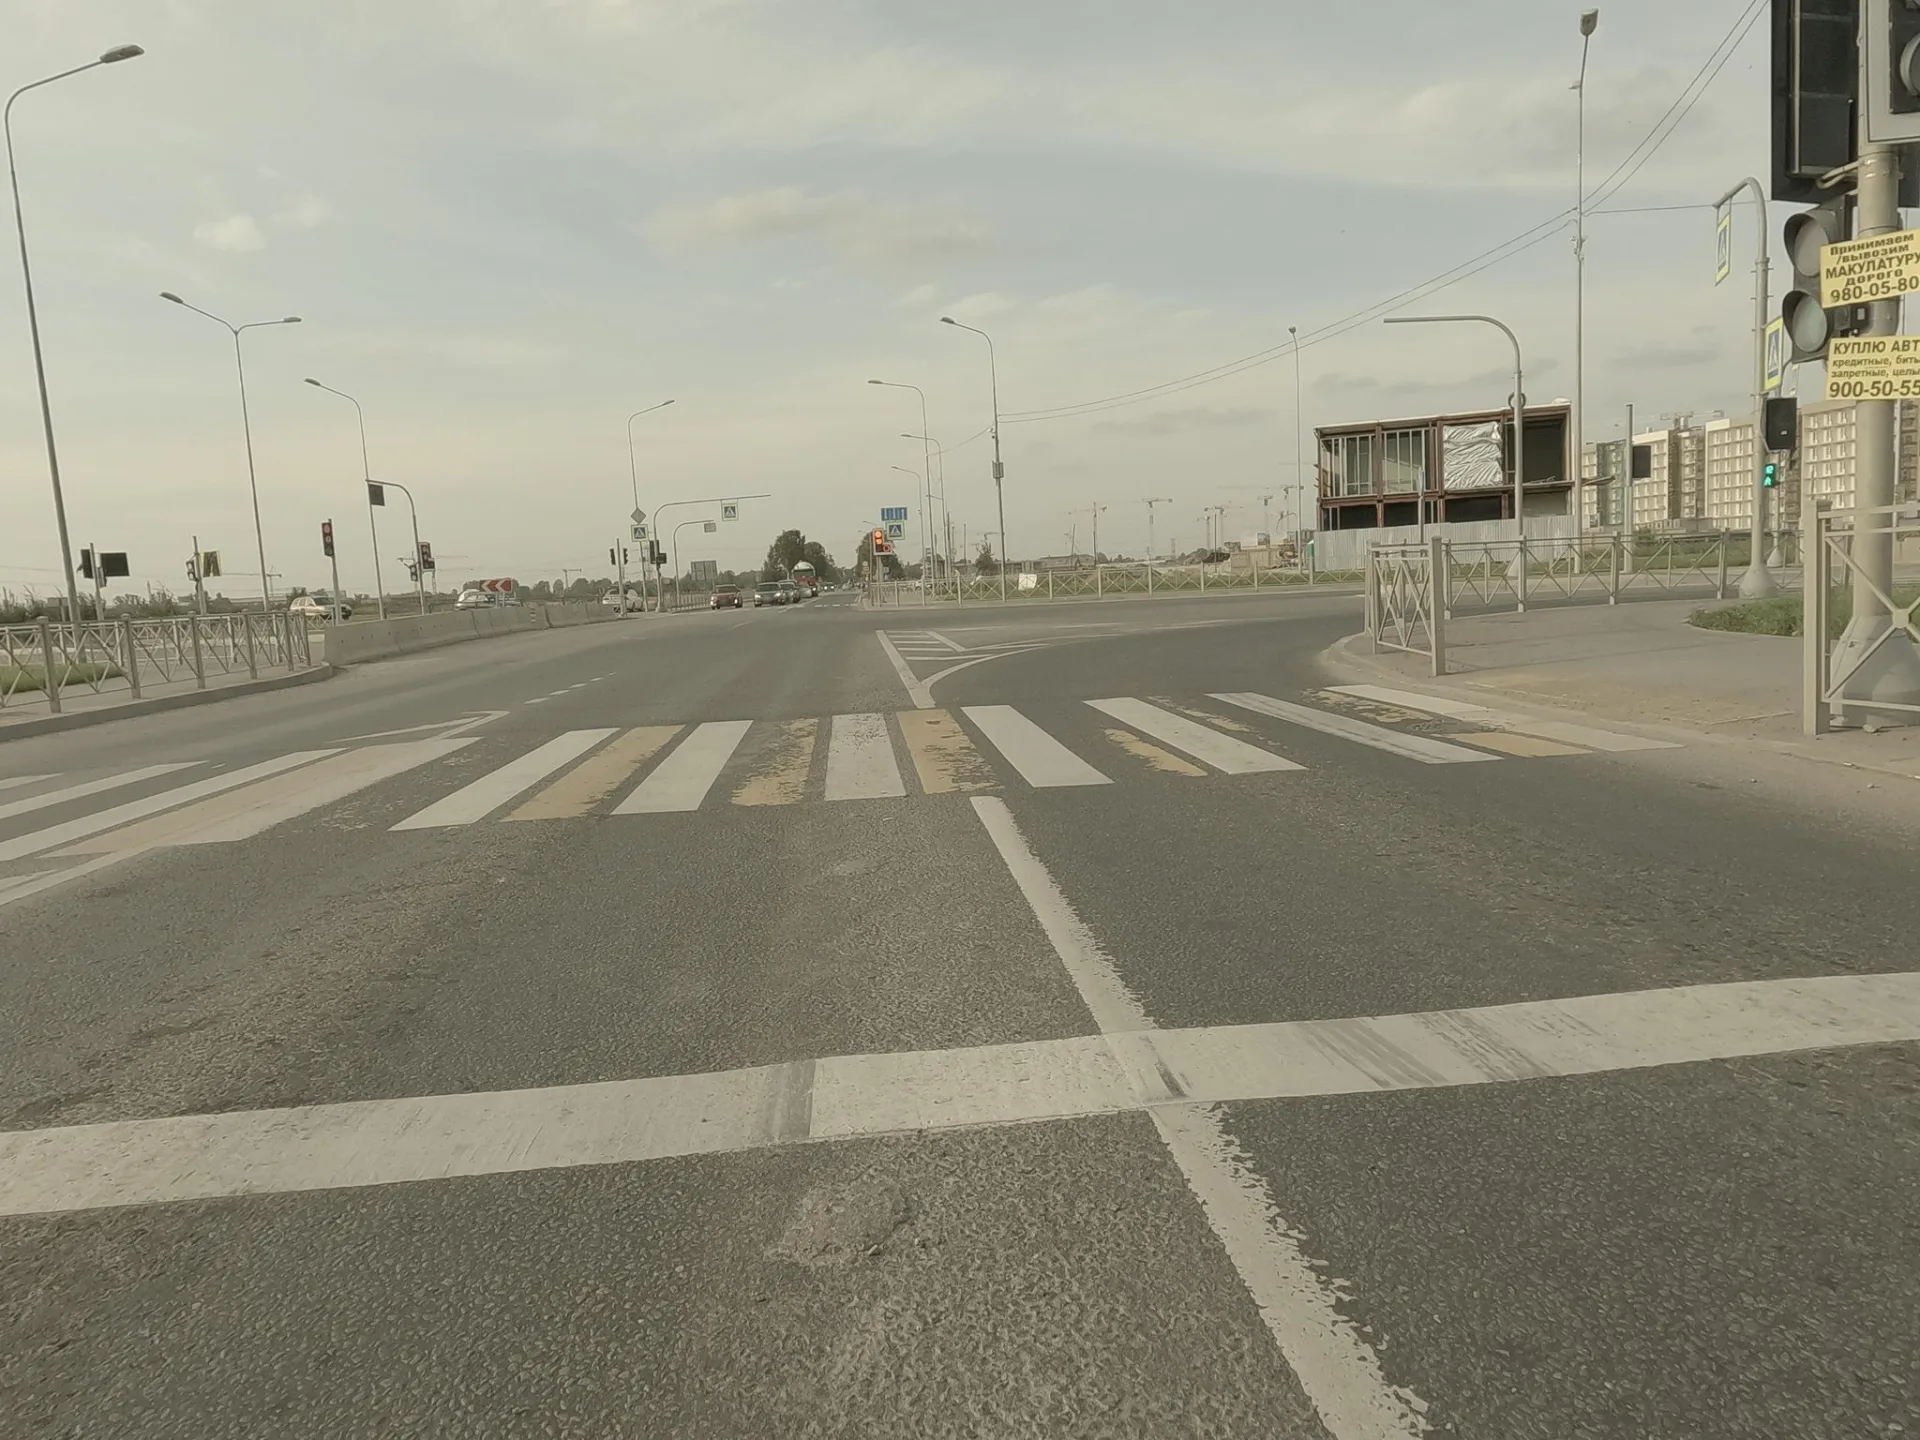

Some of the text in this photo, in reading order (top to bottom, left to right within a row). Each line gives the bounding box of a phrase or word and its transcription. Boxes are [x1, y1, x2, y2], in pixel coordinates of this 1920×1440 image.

[1830, 234, 1914, 255] Принимаем
[1826, 252, 1920, 280] МАКУЛАТУРУ
[1845, 268, 1903, 287] дорого
[1830, 275, 1919, 302] 980-05-80
[1833, 341, 1886, 354] КУПЛЮ
[1829, 380, 1920, 397] 900-50-55
